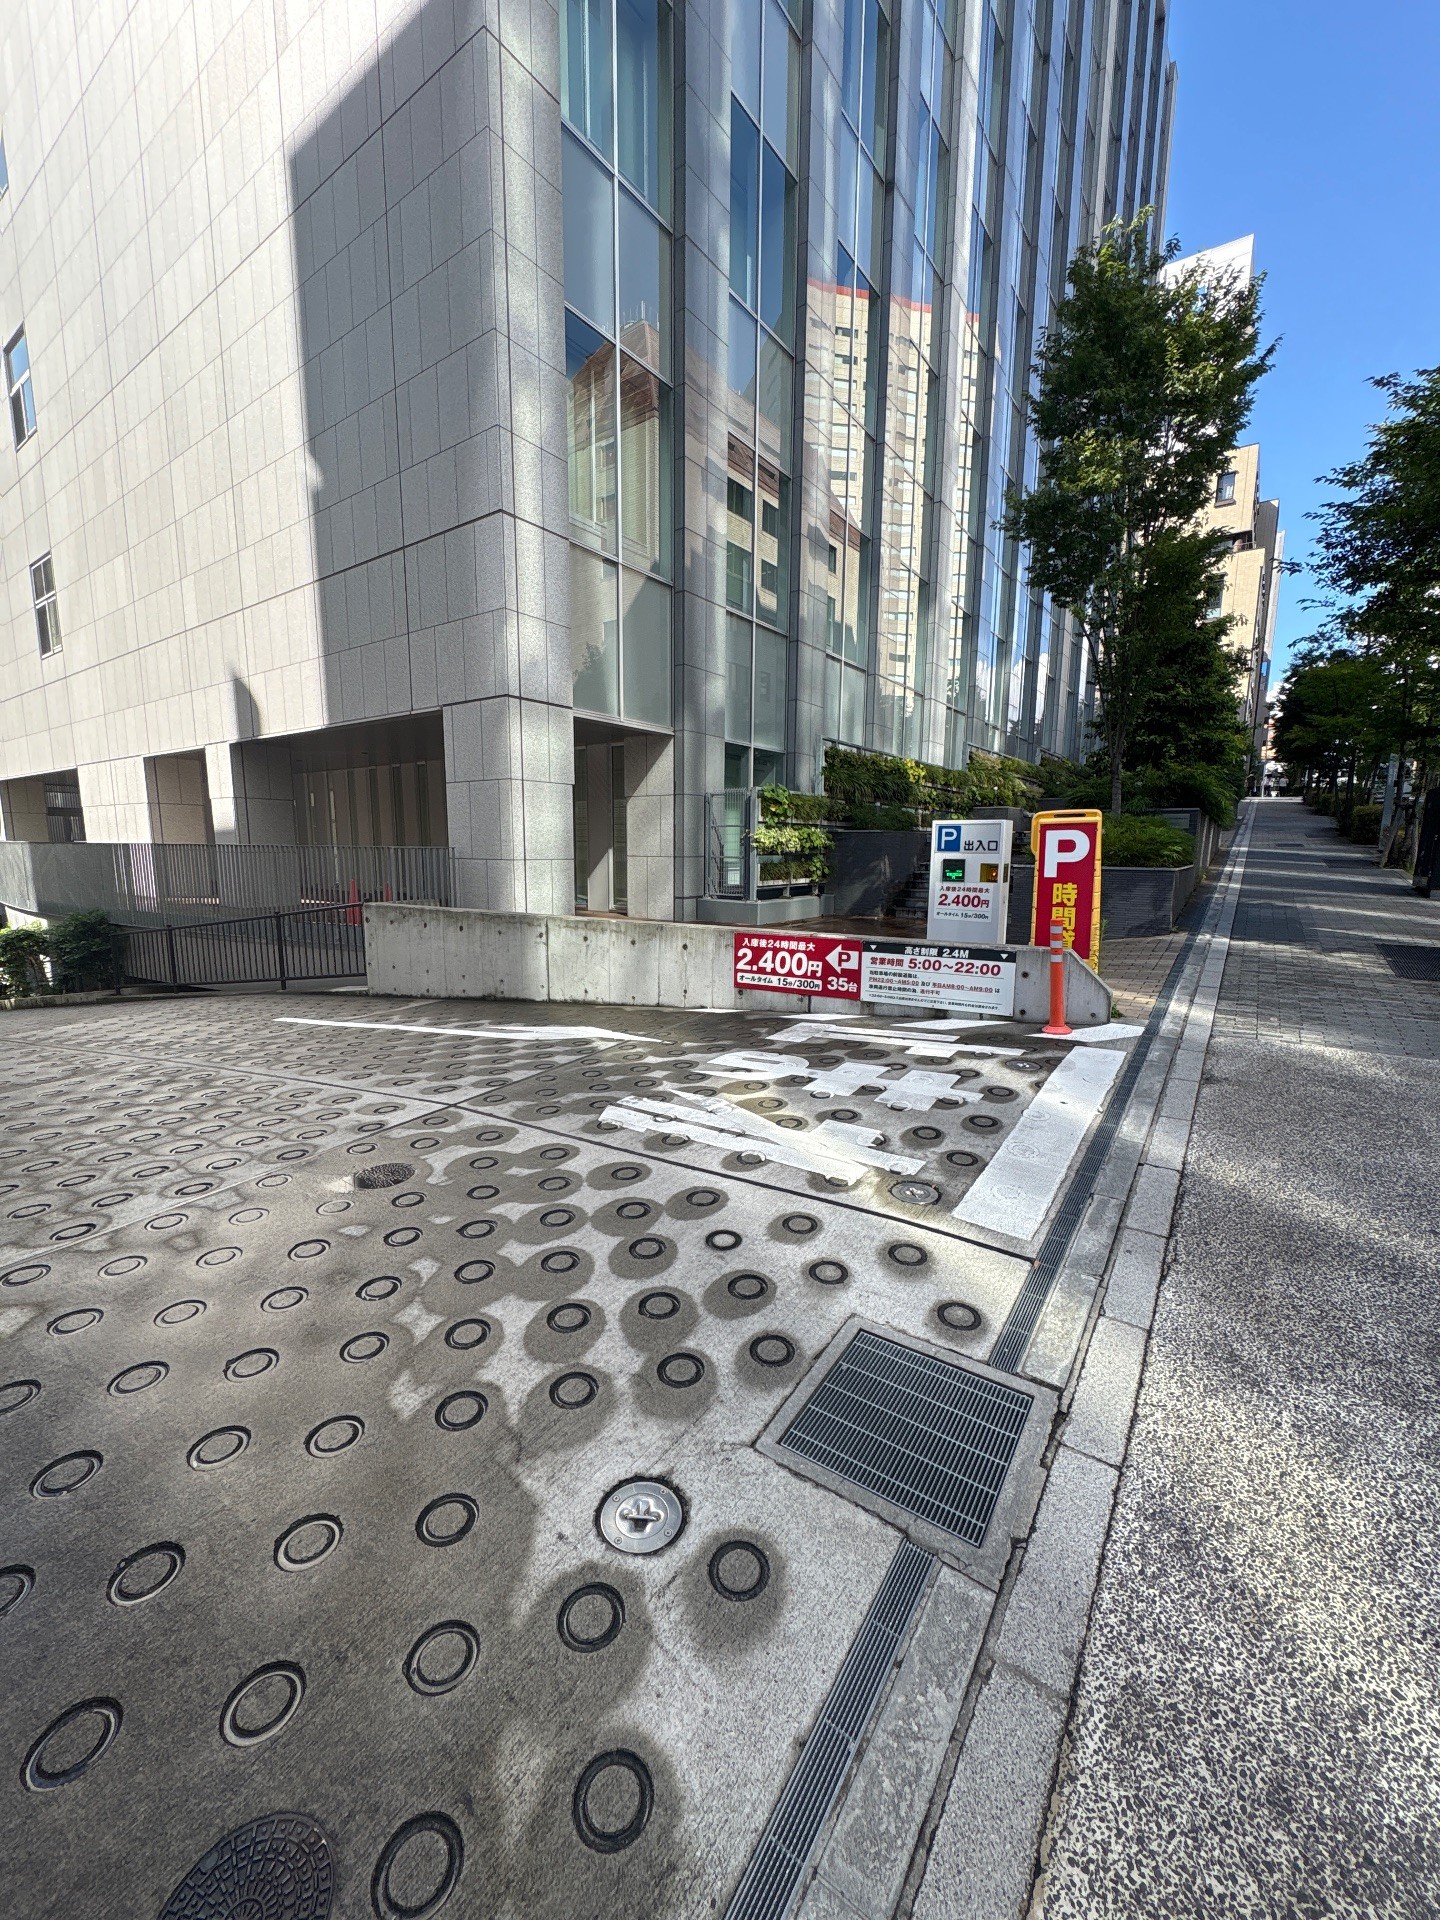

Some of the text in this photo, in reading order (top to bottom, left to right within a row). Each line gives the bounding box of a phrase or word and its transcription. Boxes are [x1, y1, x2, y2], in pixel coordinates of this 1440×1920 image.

[941, 828, 958, 850] P
[964, 840, 998, 851] 出入口
[1044, 829, 1090, 878] P
[940, 886, 990, 894] 入庫後24時間最大
[742, 938, 816, 952] 入庫後24時間最大
[904, 946, 970, 959] 高さ制限 2.4M
[837, 951, 852, 968] P
[870, 956, 905, 968] 営業時間
[739, 974, 821, 991] オールタイム 15分/300円
[827, 976, 859, 993] 35台
